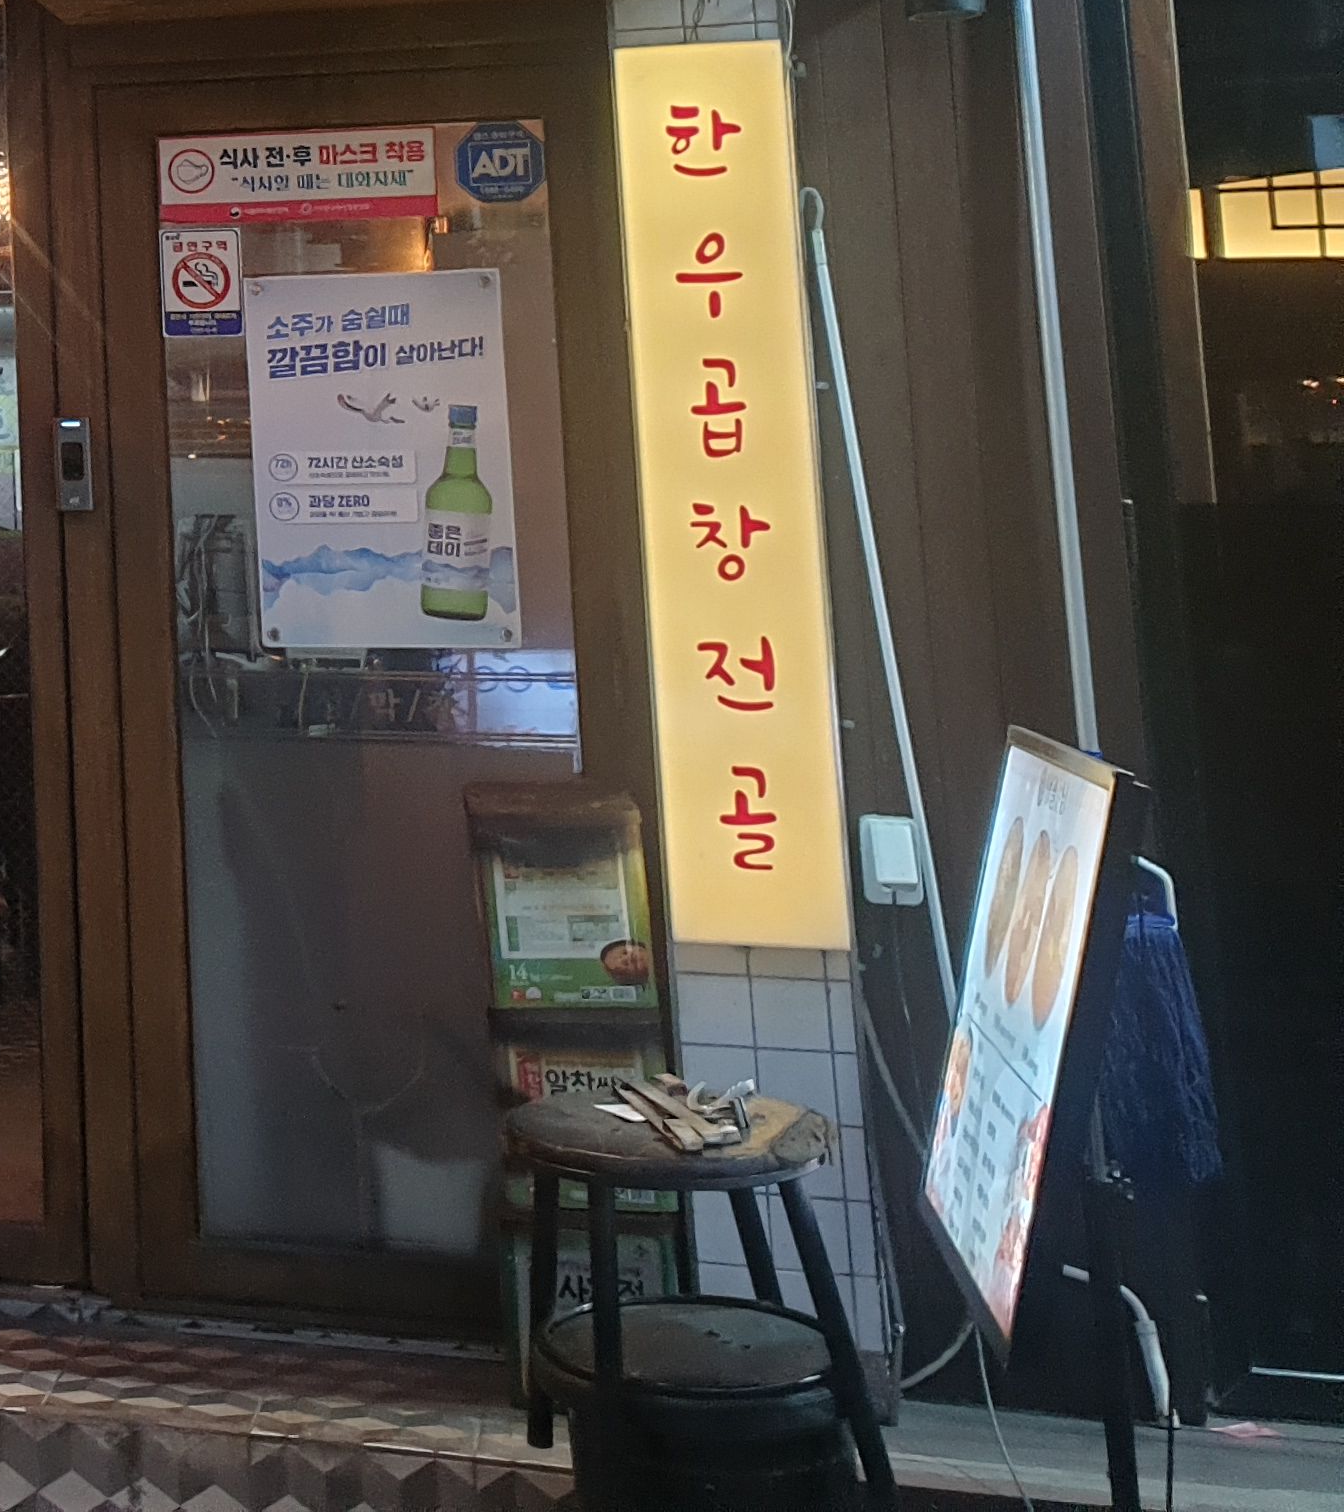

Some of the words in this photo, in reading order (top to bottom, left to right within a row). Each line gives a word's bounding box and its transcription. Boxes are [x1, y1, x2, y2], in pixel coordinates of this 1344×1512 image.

[218, 146, 260, 170] 식사
[318, 141, 379, 166] 마스크
[385, 139, 426, 163] 착용
[472, 148, 529, 178] ADT
[266, 313, 334, 340] 소주가
[340, 302, 411, 333] 숨쉴때
[266, 340, 387, 380] 깔끔함이
[394, 335, 485, 366] 살아난다!
[307, 457, 348, 470] 72시간
[351, 455, 404, 470] 산소숙성
[337, 494, 370, 508] ZERO
[664, 103, 778, 873] 한우곱창전골
